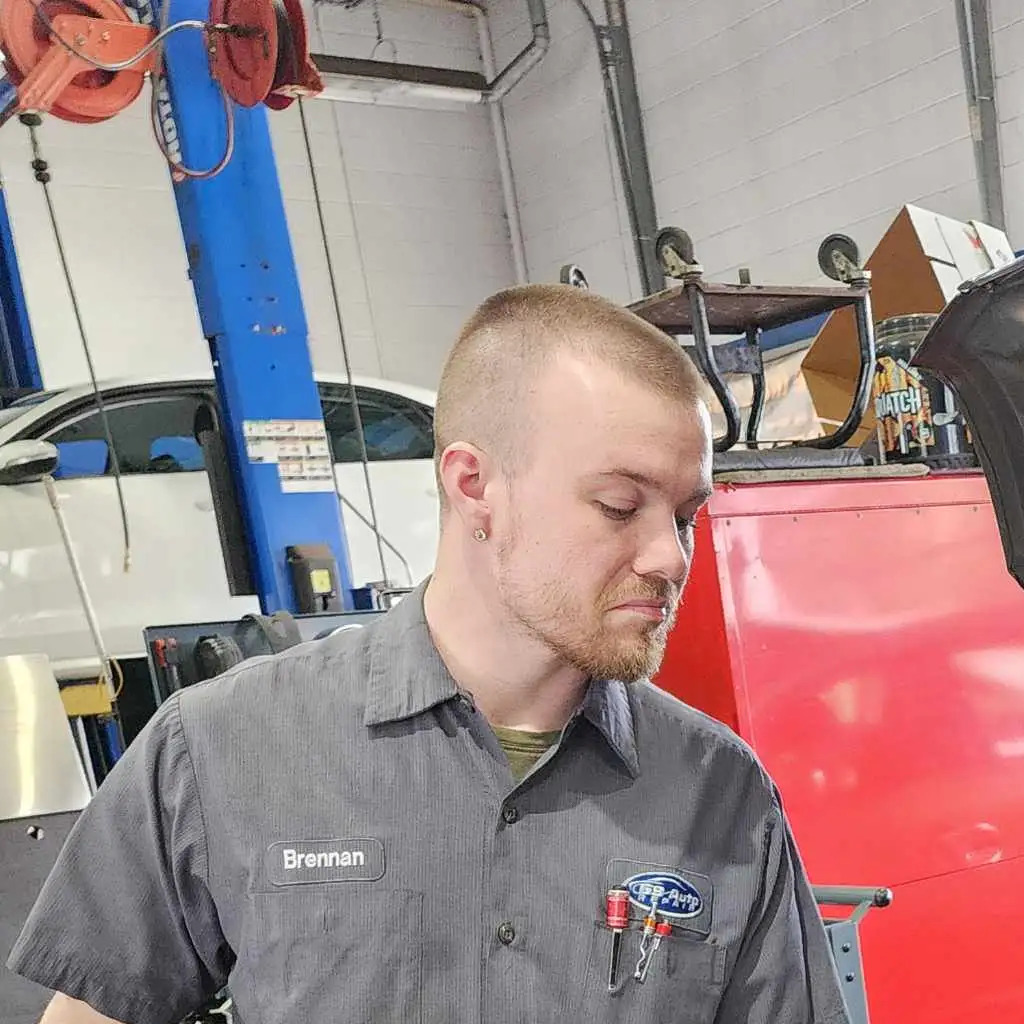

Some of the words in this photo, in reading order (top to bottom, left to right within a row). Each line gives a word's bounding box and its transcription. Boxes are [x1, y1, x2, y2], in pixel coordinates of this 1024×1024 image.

[283, 849, 364, 869] Brennan
[637, 893, 695, 912] RPAIR
[668, 888, 699, 906] Auto
